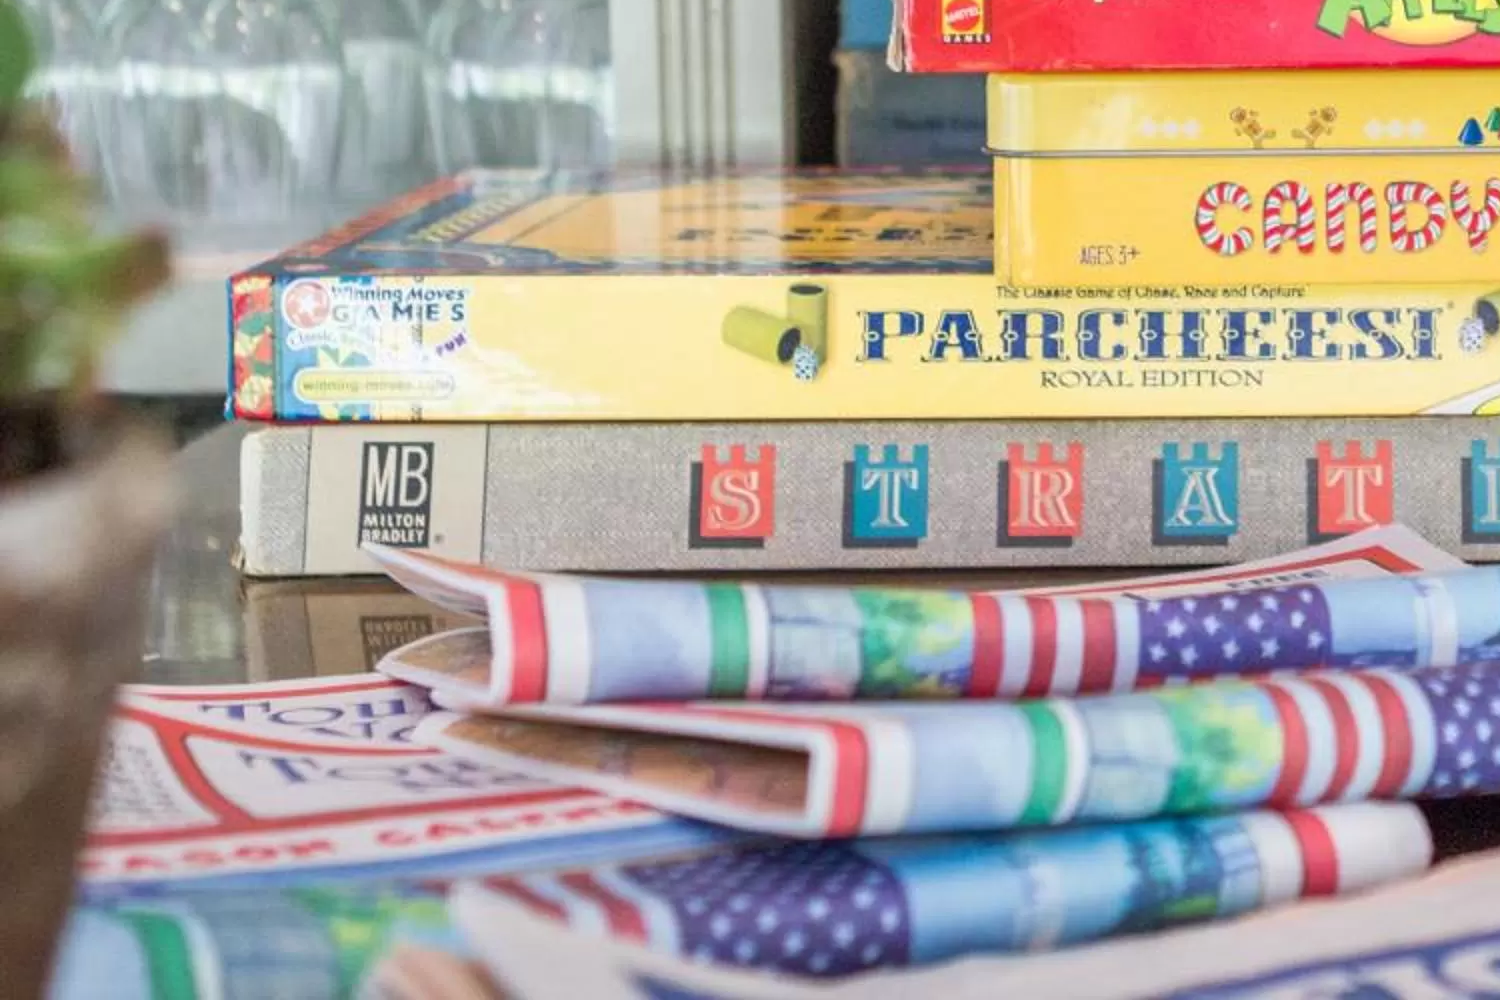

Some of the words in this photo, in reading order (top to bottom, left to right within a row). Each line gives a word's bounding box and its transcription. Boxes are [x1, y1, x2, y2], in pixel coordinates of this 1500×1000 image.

[1079, 244, 1115, 265] AGES
[1118, 245, 1142, 266] 3+
[406, 286, 465, 301] Moves
[996, 285, 1019, 299] The
[1022, 285, 1072, 299] Classic
[1075, 286, 1114, 299] Game
[1117, 285, 1132, 299] of
[1184, 286, 1218, 298] Race
[1222, 285, 1248, 298] and
[1250, 285, 1307, 300] Capture
[332, 303, 465, 322] GAMES
[855, 307, 1444, 363] PARCHEESI
[1040, 369, 1133, 389] ROYAL
[1141, 369, 1265, 389] EDITION
[364, 445, 429, 507] MB
[363, 513, 426, 528] MILTON
[361, 528, 426, 543] BRADLEY
